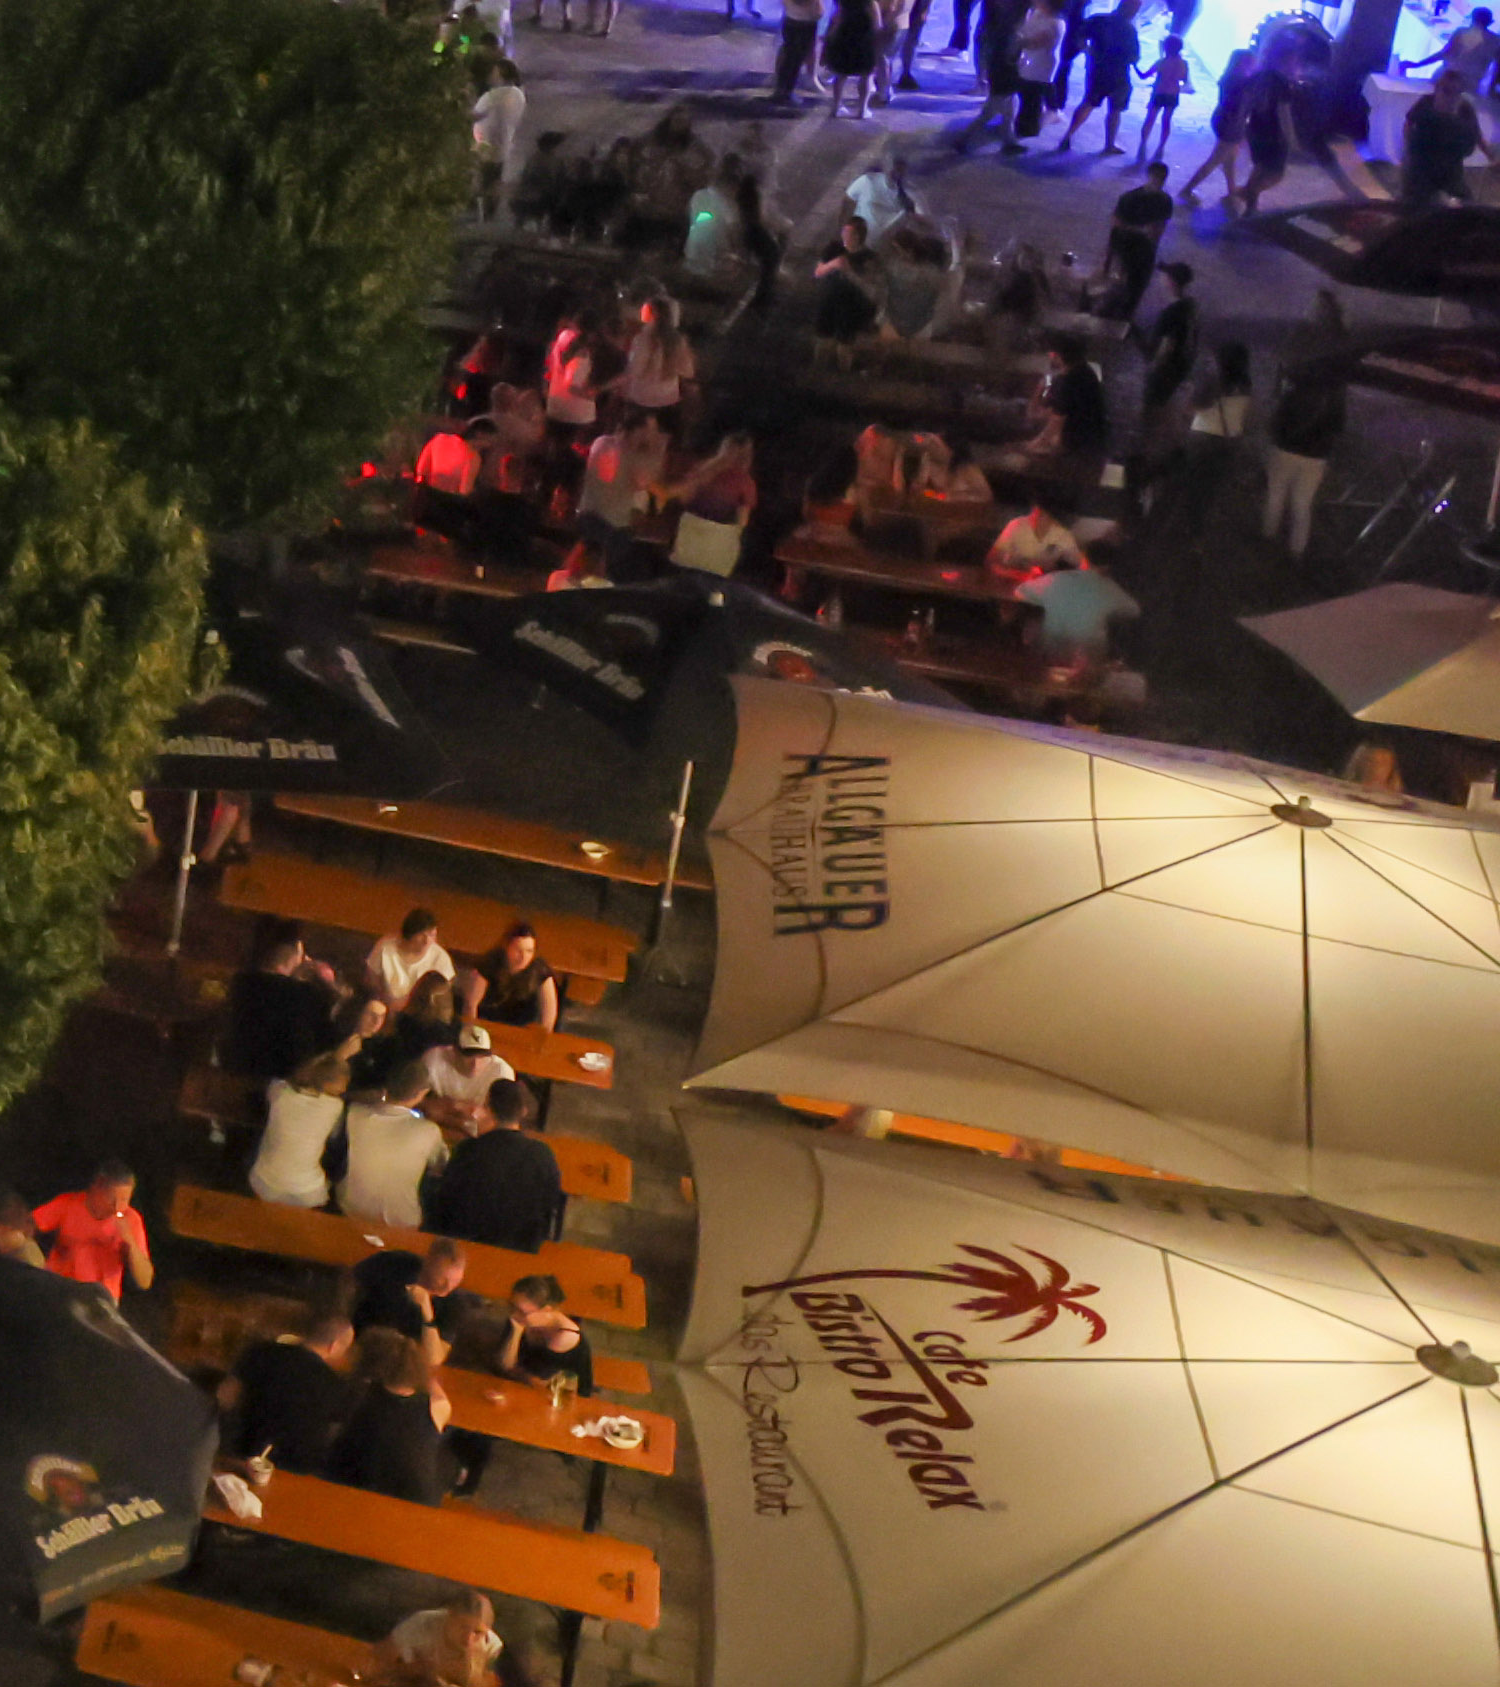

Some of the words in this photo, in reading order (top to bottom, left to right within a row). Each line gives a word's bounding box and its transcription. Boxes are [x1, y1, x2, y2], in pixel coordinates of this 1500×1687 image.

[743, 1355, 803, 1517] Restaurant
[790, 1292, 892, 1379] Bistro
[851, 1340, 987, 1511] Relax
